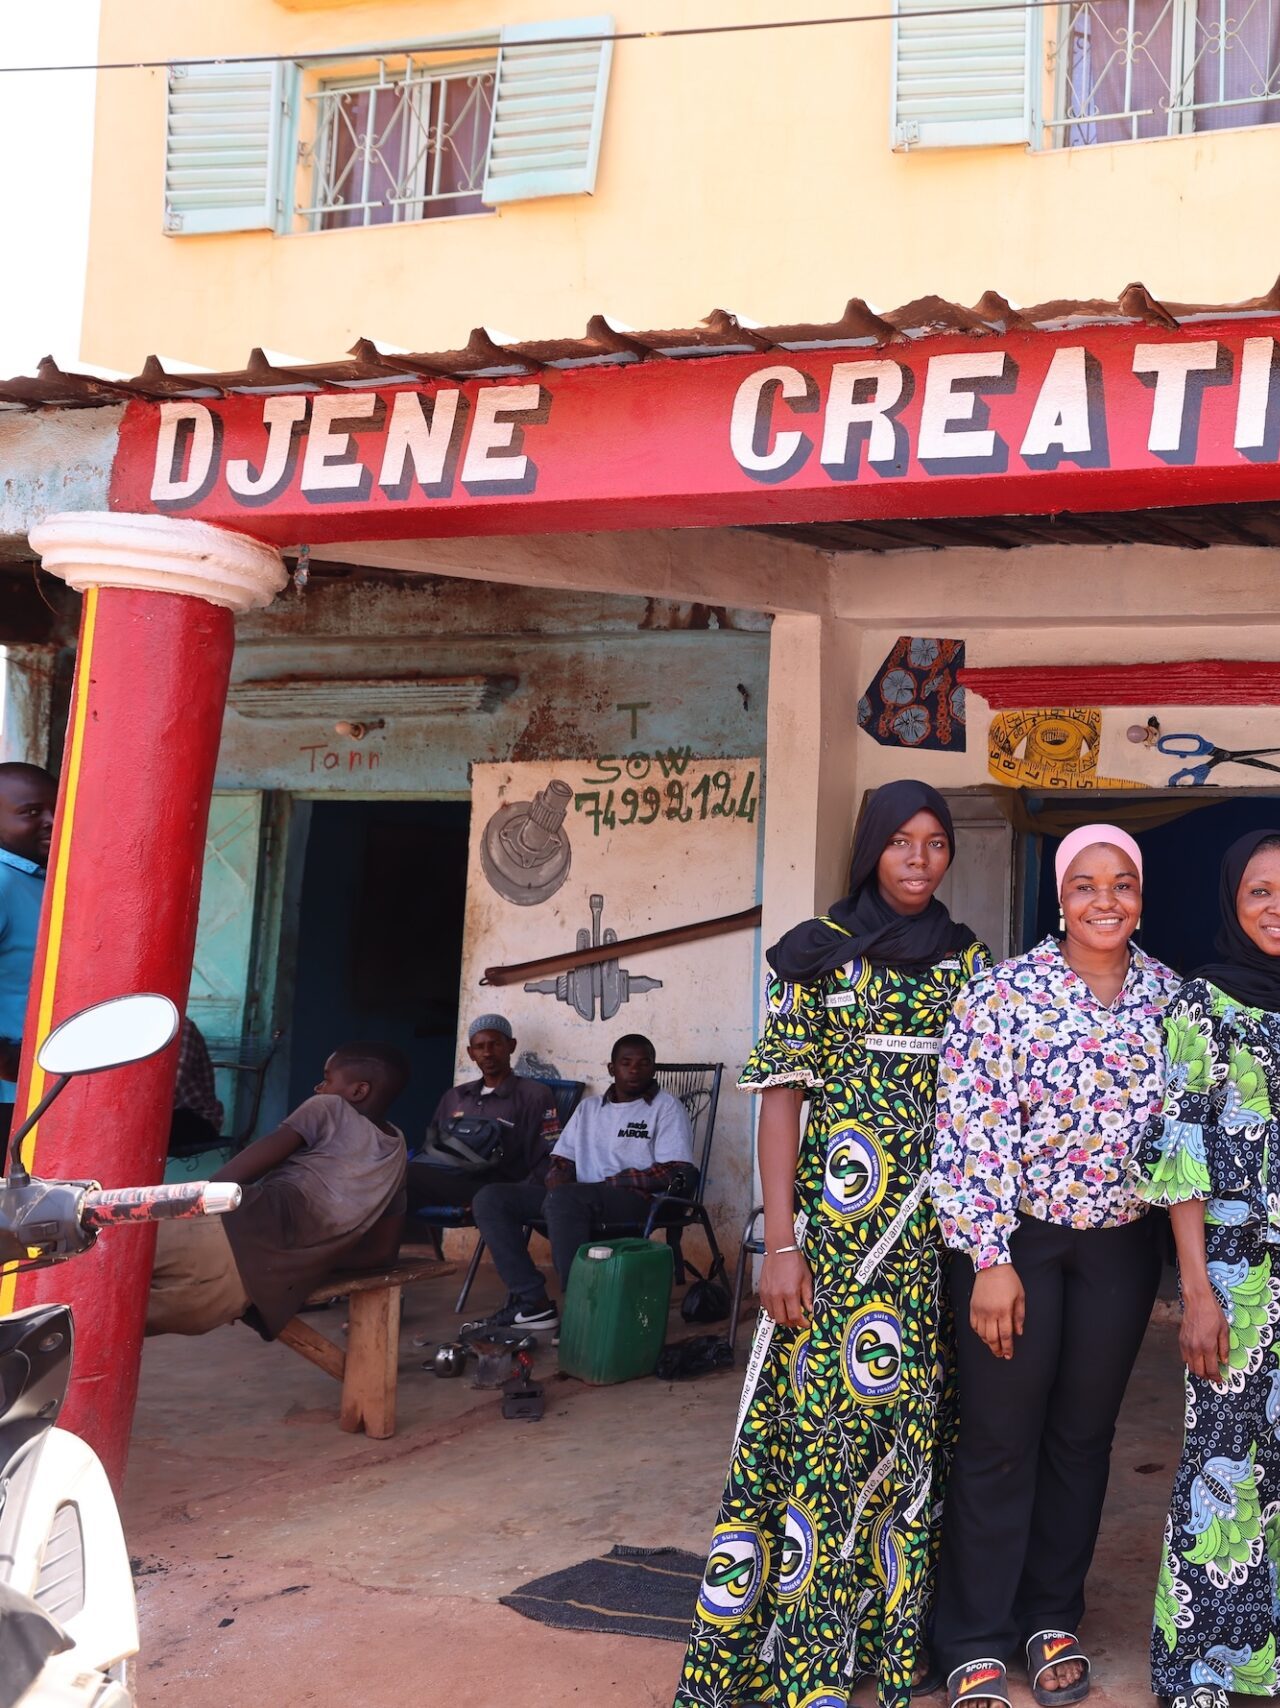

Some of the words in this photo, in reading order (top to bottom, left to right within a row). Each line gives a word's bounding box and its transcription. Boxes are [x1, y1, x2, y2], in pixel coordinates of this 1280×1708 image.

[150, 384, 545, 503] DJENE
[582, 745, 692, 785] SOW
[574, 770, 758, 837] 74992124
[886, 1039, 907, 1049] une
[858, 1259, 875, 1280] Sois
[748, 1361, 759, 1382] une
[877, 1460, 893, 1478] pas
[1042, 1632, 1067, 1640] SPORT
[965, 1662, 994, 1673] SPORT
